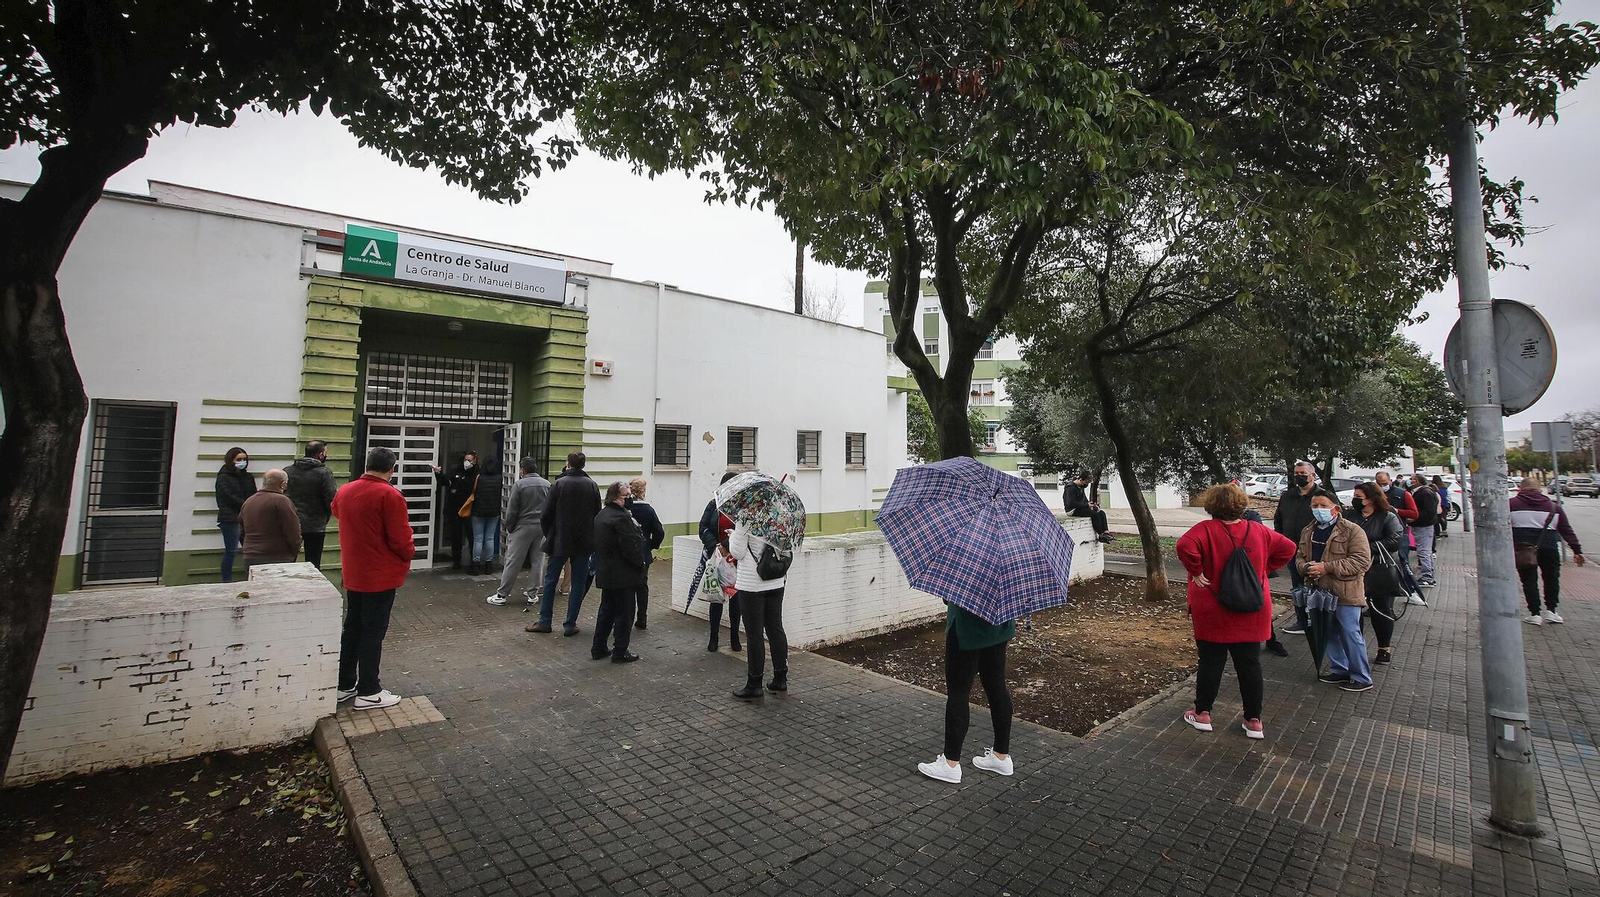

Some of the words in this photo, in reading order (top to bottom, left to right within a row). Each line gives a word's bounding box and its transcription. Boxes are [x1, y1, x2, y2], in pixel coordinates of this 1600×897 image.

[407, 248, 452, 265] Centro
[455, 255, 471, 267] de
[474, 258, 509, 274] Salud
[405, 264, 418, 274] La
[420, 266, 454, 281] Granja
[462, 273, 476, 283] Dr.
[478, 275, 513, 289] Manuel
[515, 282, 546, 294] Blanco
